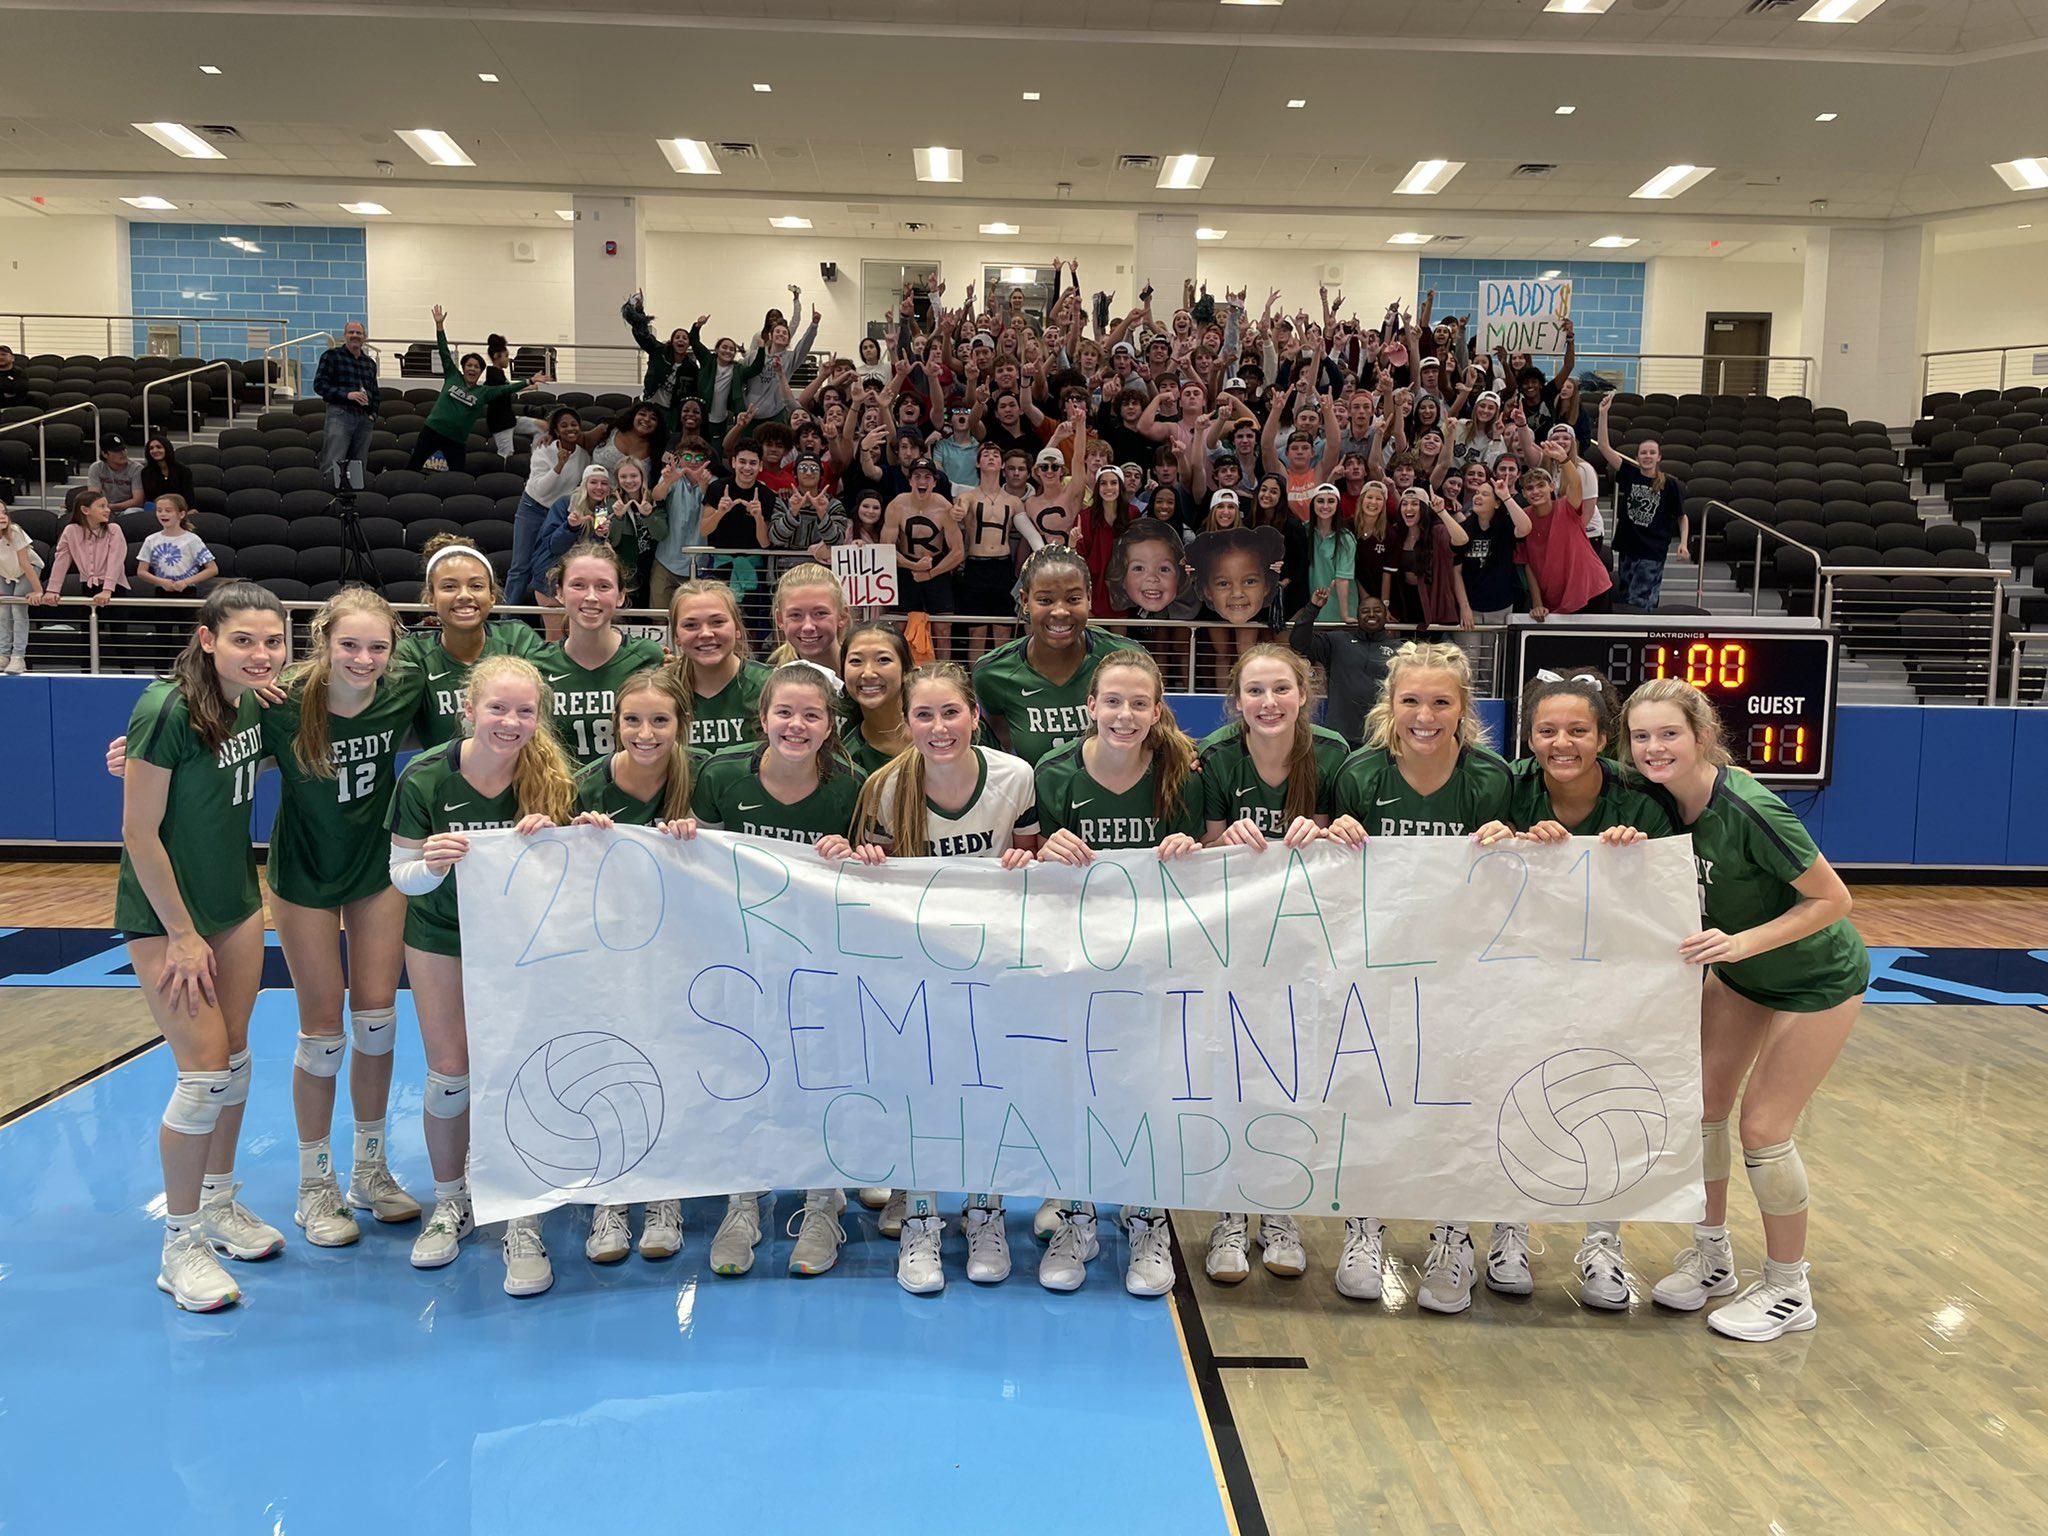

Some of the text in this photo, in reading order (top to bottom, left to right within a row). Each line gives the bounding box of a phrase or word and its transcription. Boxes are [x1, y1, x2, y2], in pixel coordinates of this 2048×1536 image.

[1486, 321, 1563, 352] MONEY
[837, 548, 884, 576] HILL
[841, 573, 895, 605] ILLS
[1649, 631, 1705, 639] DAKTRONICS
[553, 690, 616, 716] REED
[1026, 704, 1093, 732] REED
[1748, 695, 1805, 715] GUEST
[572, 718, 616, 756] 18
[688, 718, 745, 744] EEDY
[1762, 726, 1805, 763] 11
[331, 730, 394, 764] EEDY
[232, 760, 255, 806] 11
[337, 761, 377, 803] 12
[923, 829, 994, 857] REEDY
[1079, 817, 1160, 843] REEDY
[504, 838, 1602, 972] 20 REGIONAL 21
[688, 964, 1472, 1107] SEMI-FINAL
[822, 1092, 1347, 1211] CHAMPS!
